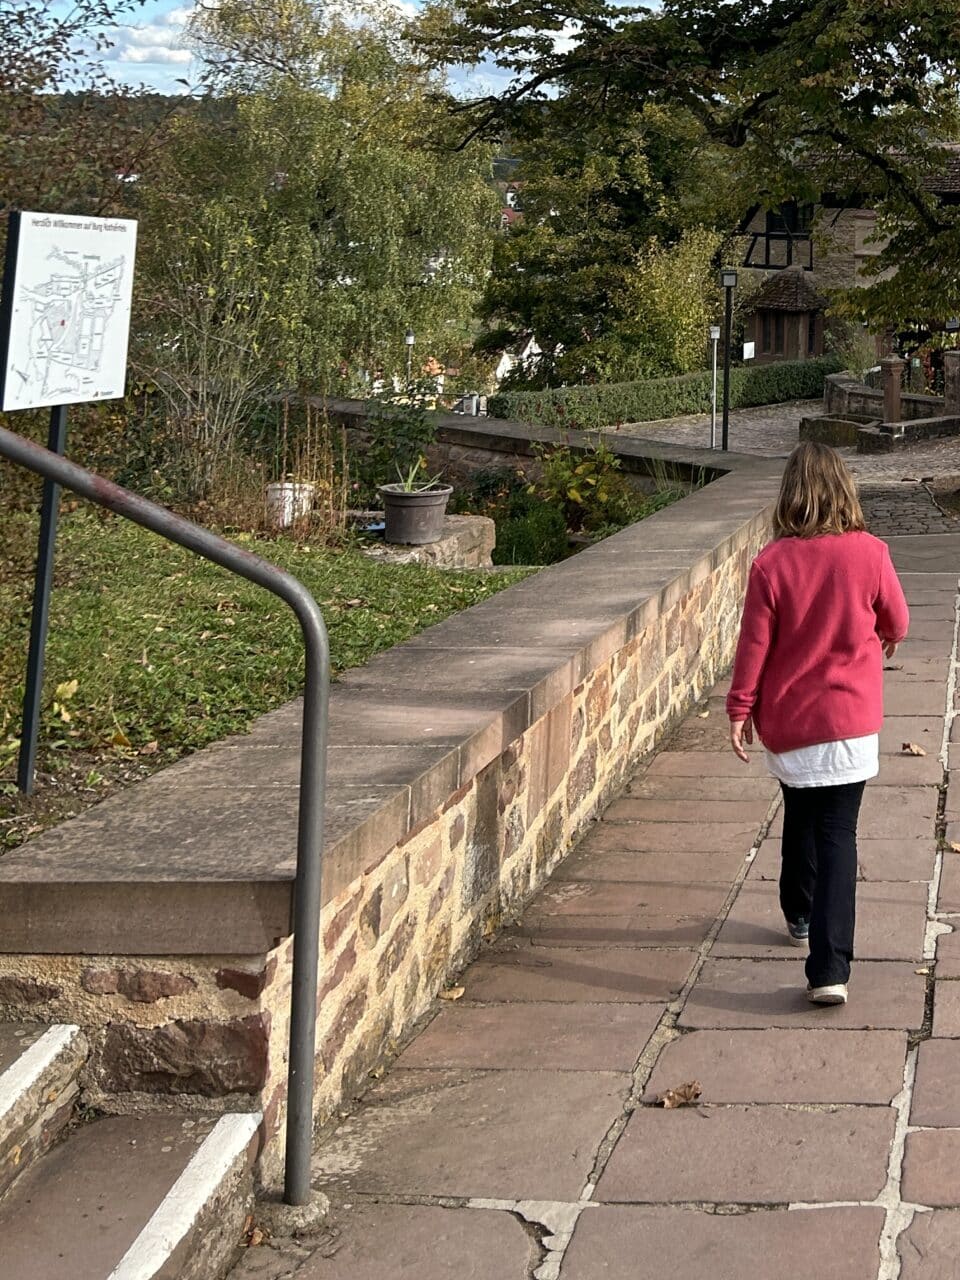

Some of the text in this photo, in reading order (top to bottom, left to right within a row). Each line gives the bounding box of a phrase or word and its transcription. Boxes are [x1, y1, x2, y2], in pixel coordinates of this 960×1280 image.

[53, 219, 82, 229] Willkommen
[83, 222, 91, 230] auf
[92, 222, 102, 232] Burg
